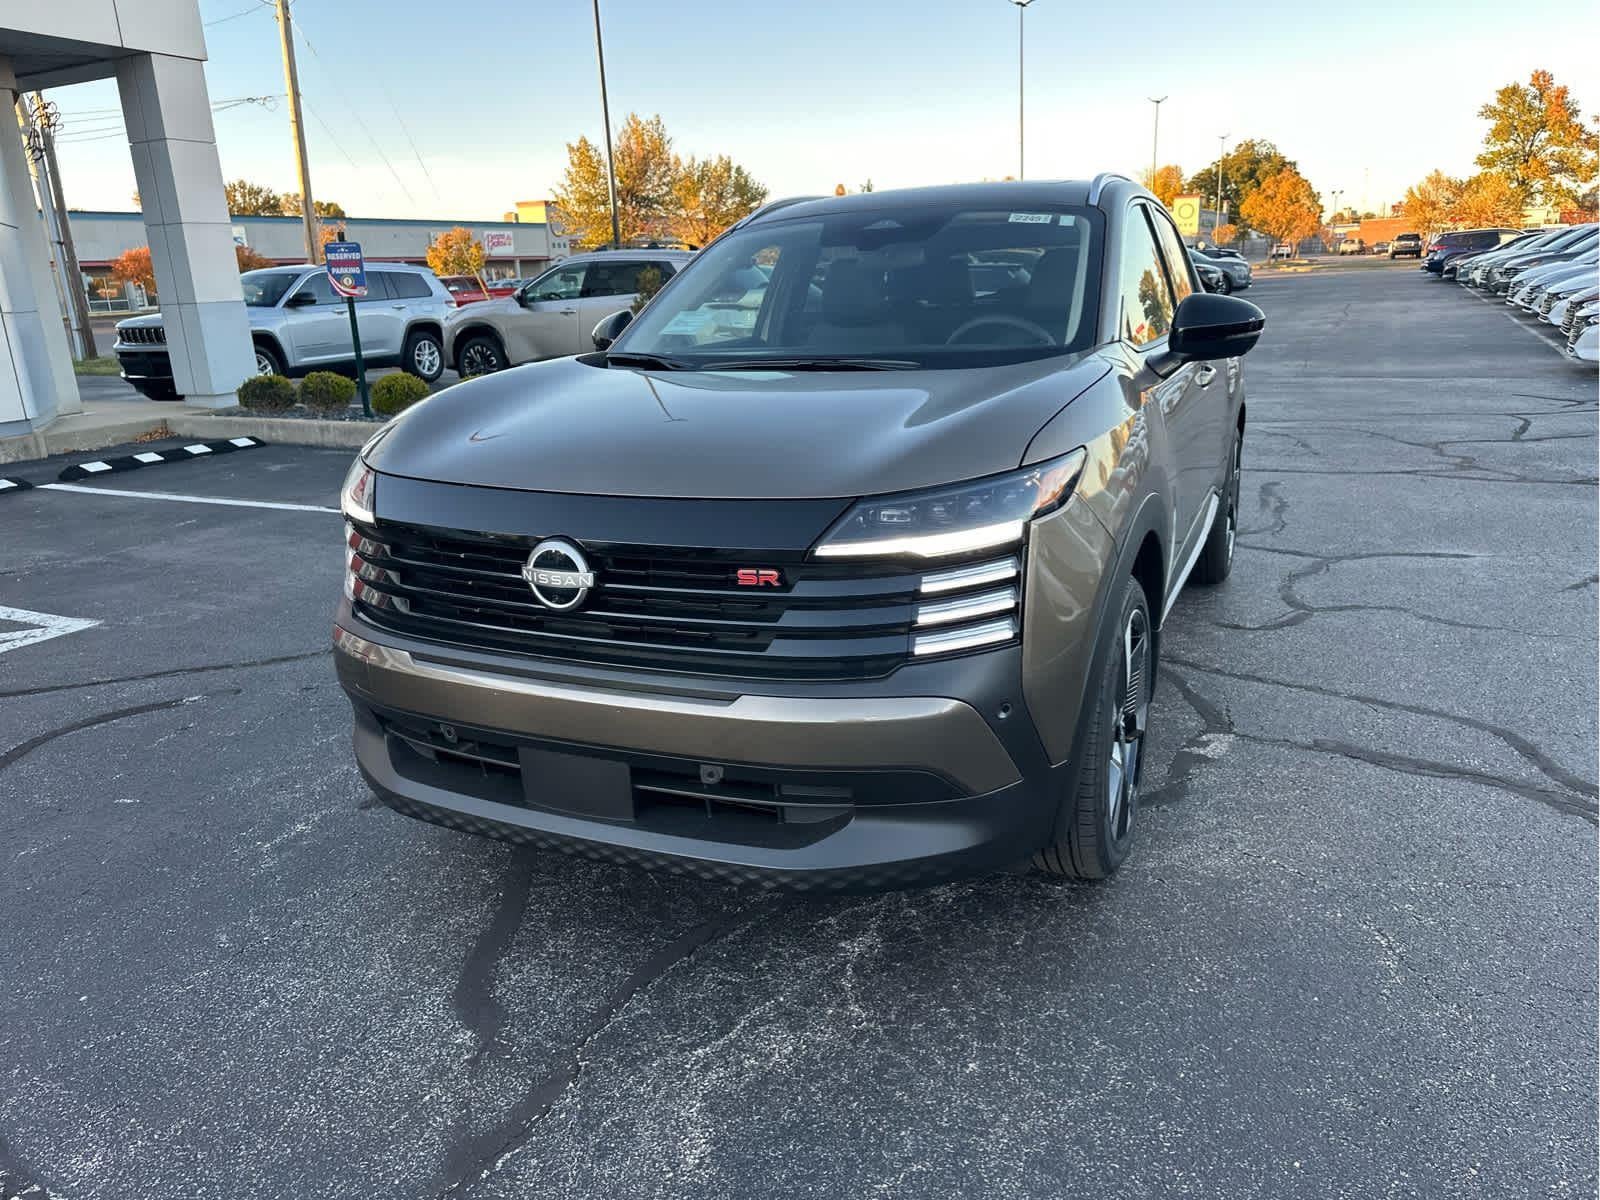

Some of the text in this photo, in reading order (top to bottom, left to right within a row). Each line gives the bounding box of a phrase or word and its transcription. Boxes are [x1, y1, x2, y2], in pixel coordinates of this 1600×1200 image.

[326, 252, 361, 260] RESERVED
[331, 266, 361, 274] PARKING
[522, 568, 592, 586] NISSAN
[737, 569, 781, 586] SR
